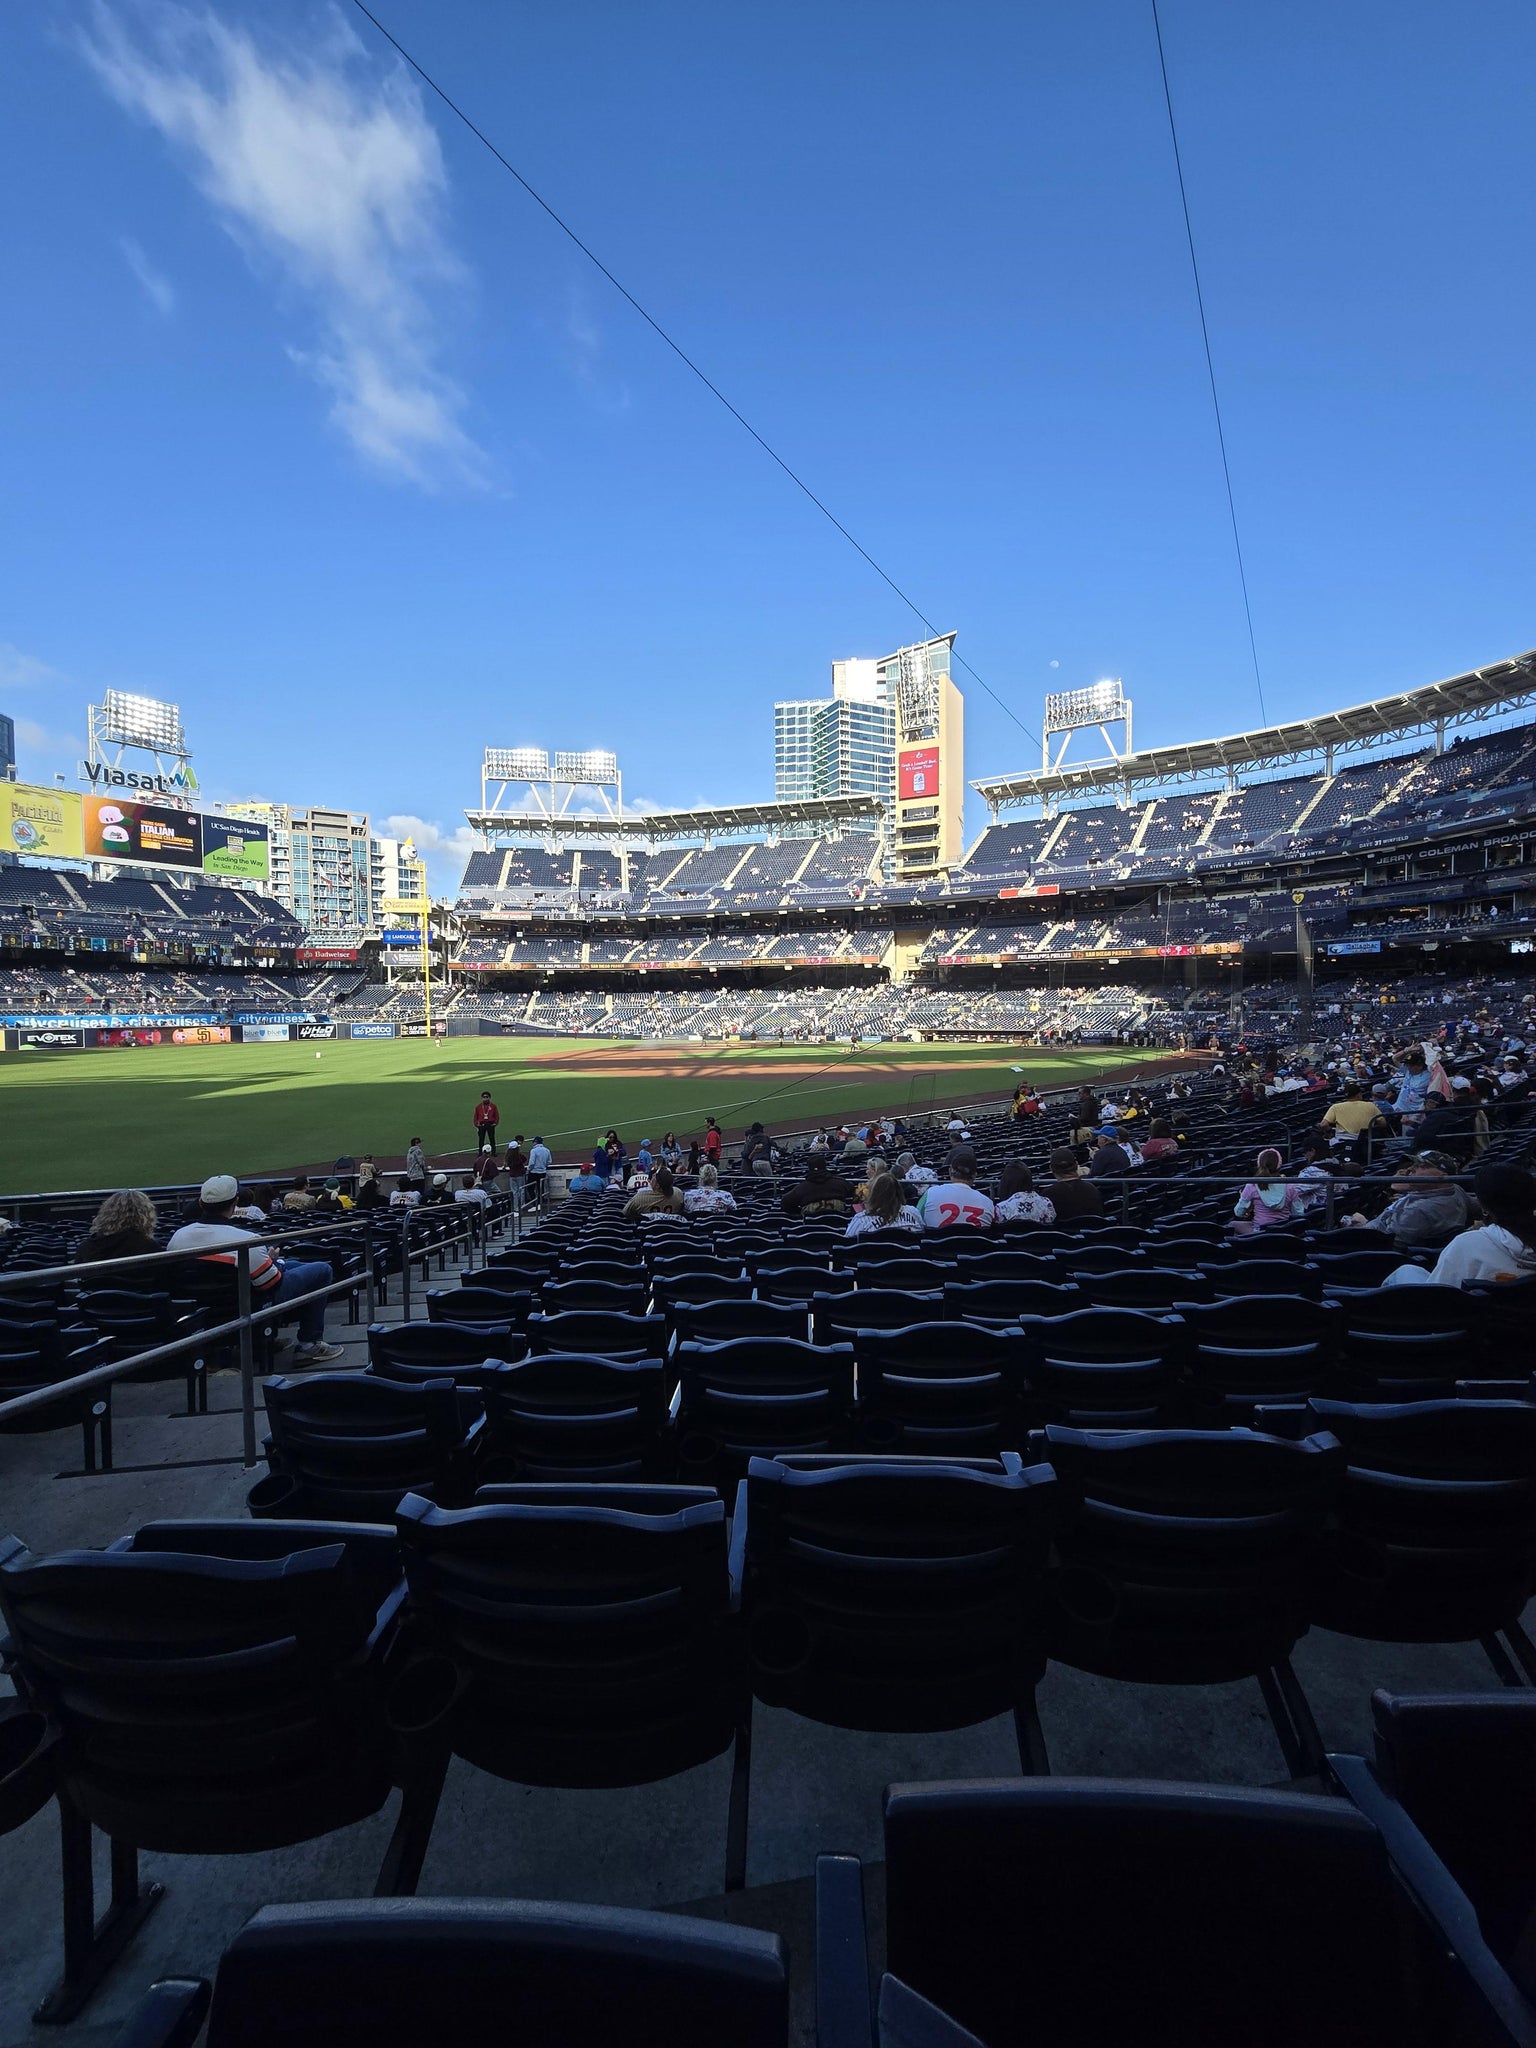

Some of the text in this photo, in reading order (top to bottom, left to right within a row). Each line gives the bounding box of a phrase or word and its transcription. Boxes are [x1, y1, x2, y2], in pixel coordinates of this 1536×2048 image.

[84, 761, 167, 793] Viasat
[140, 824, 175, 837] ITALIAN
[1376, 852, 1413, 865] JERRY
[1418, 841, 1479, 859] COLEMAN
[212, 855, 238, 864] Leading
[250, 859, 263, 867] Way
[233, 864, 248, 872] Diego
[254, 948, 281, 958] PADRES
[365, 1025, 392, 1034] petco
[27, 1032, 77, 1043] EVOTEK
[871, 1211, 916, 1230] HOMAN
[939, 1203, 984, 1227] 23
